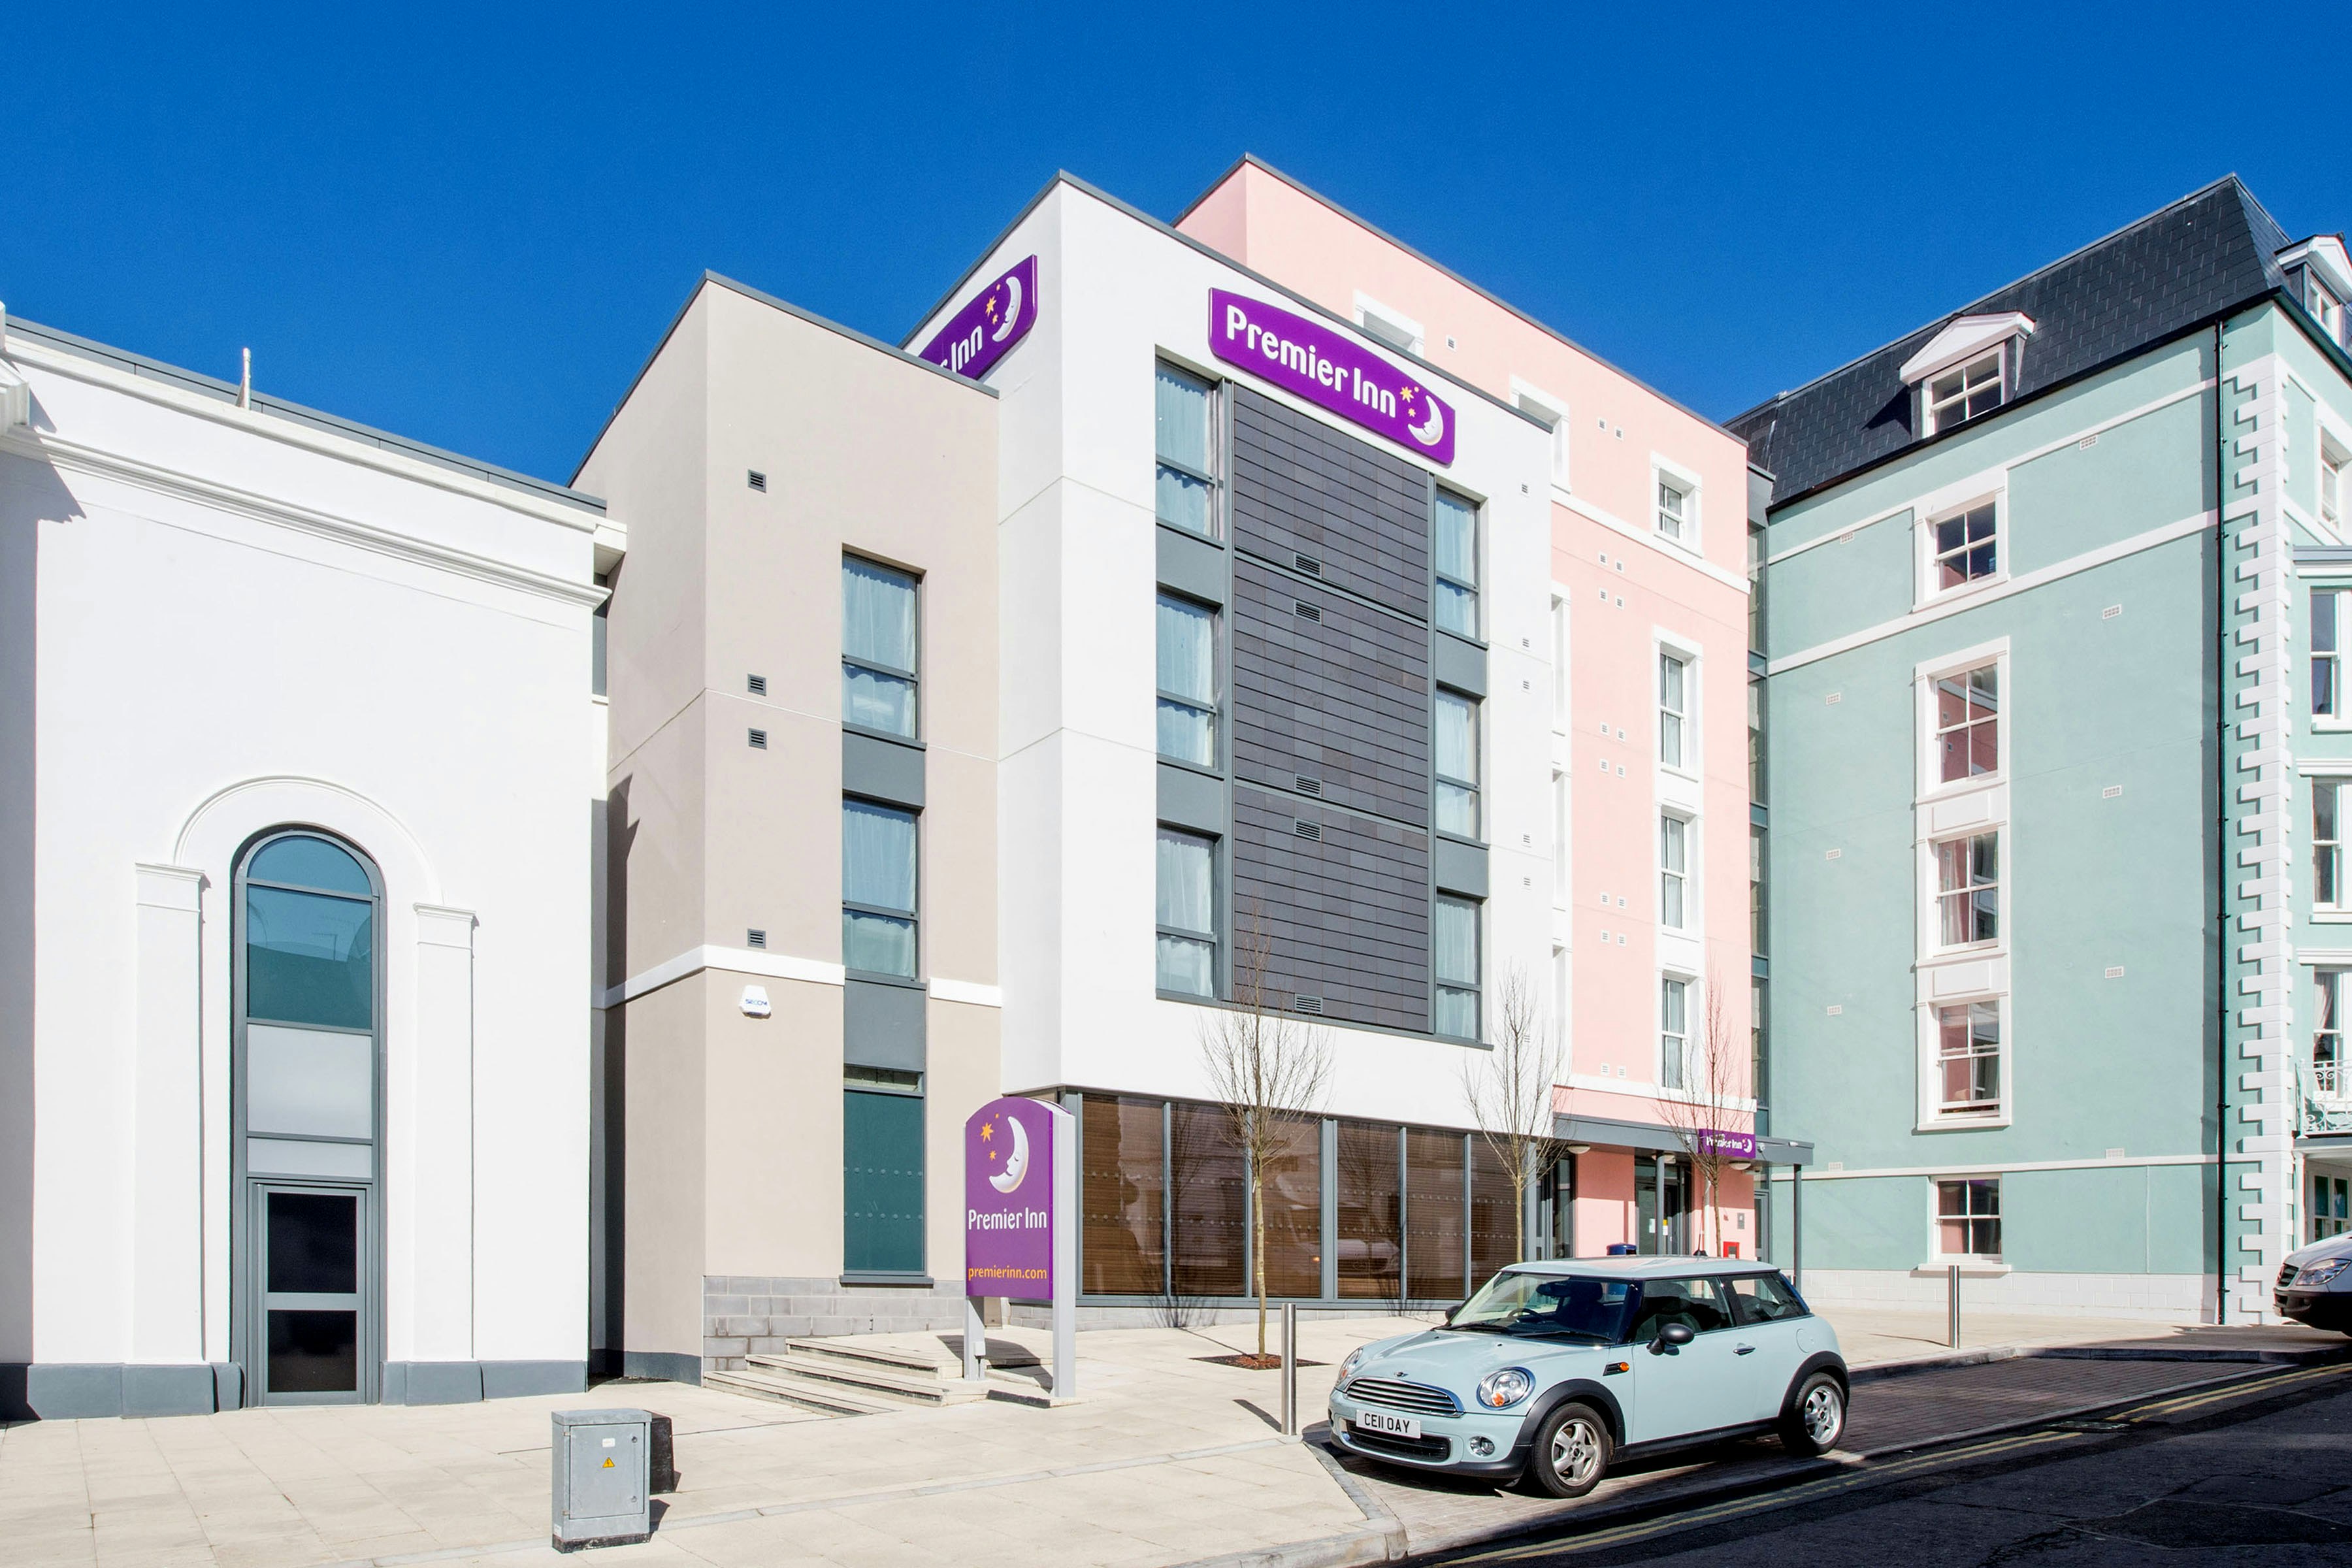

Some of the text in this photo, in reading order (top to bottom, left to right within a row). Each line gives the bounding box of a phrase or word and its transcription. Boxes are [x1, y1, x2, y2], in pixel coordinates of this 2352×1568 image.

[951, 325, 983, 373] Inn
[1226, 304, 1396, 418] Premier Inn
[1732, 1139, 1742, 1149] Inn
[968, 1206, 1047, 1230] Premier Inn
[968, 1264, 1047, 1281] premierinn.com
[1364, 1413, 1410, 1433] CE11 OAY
